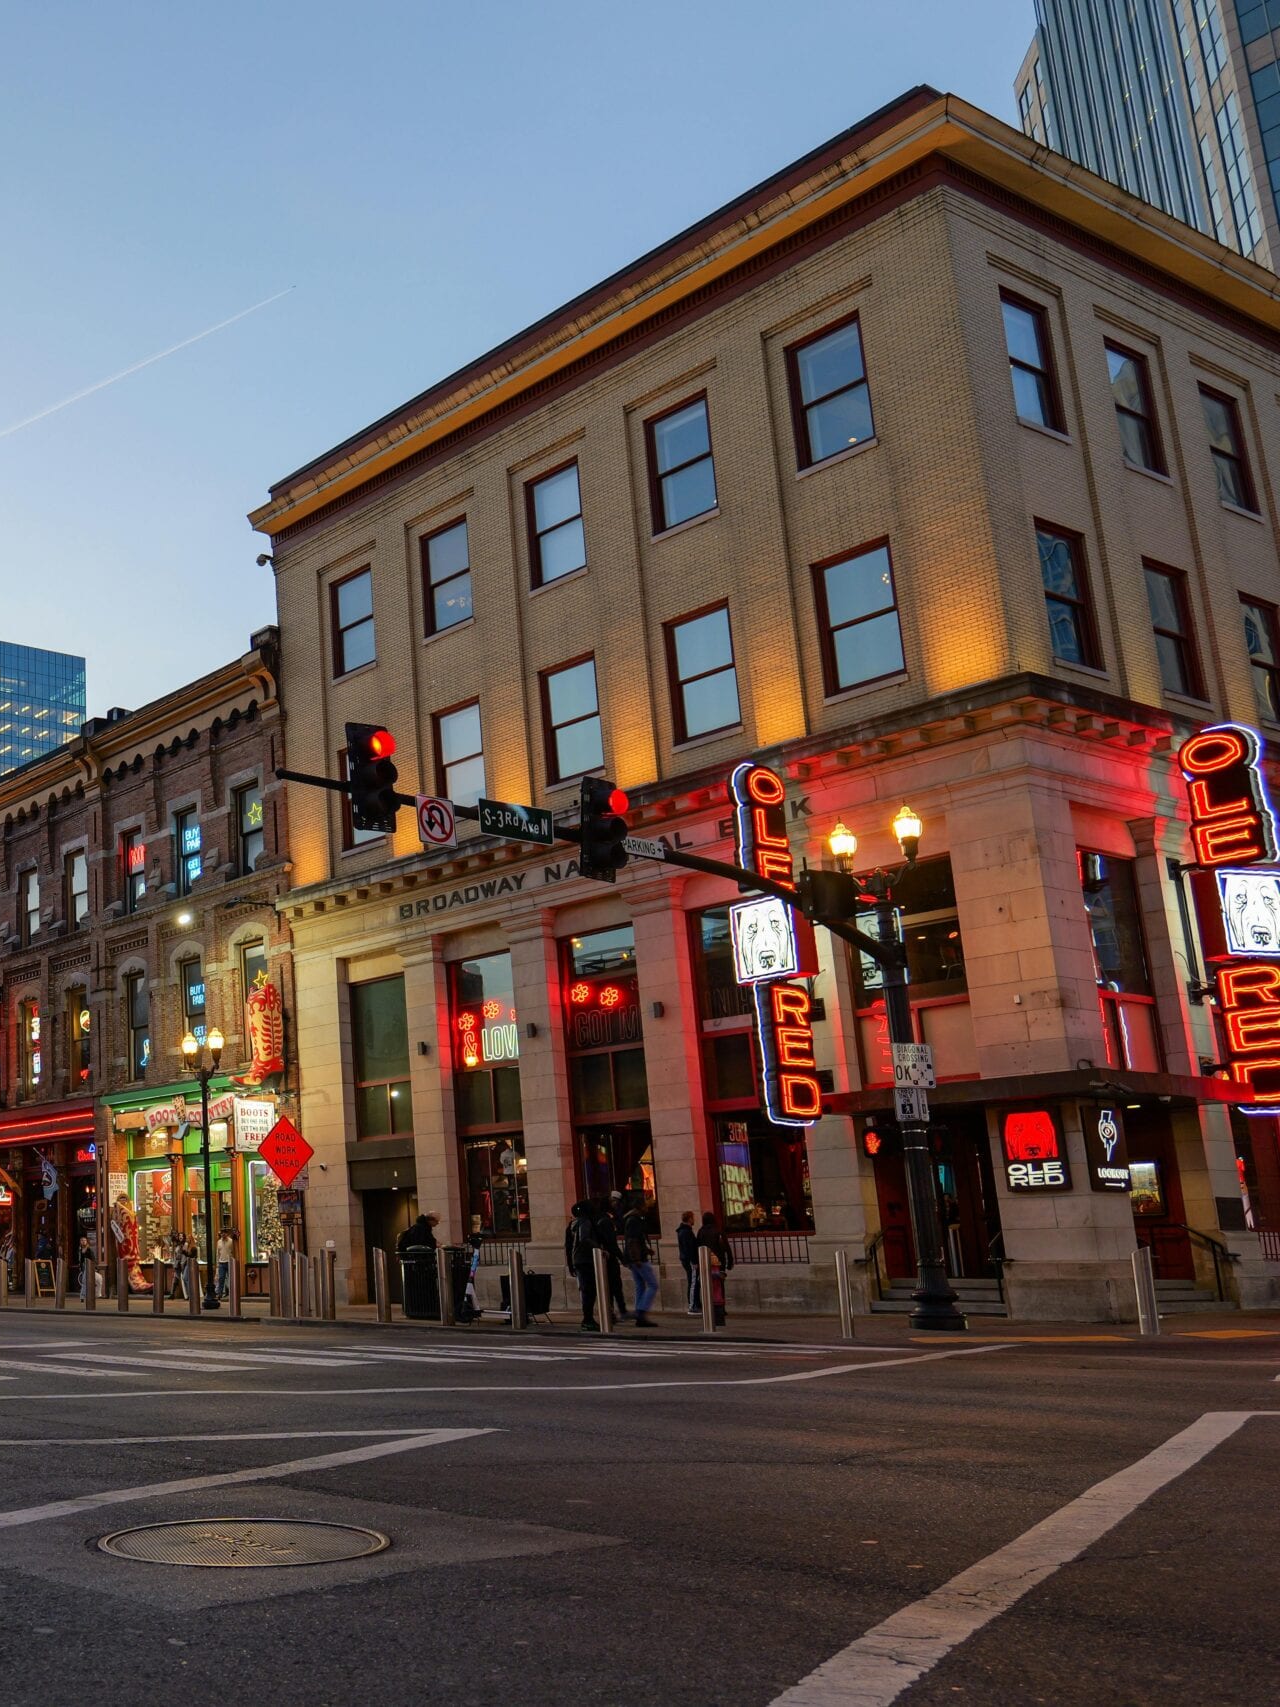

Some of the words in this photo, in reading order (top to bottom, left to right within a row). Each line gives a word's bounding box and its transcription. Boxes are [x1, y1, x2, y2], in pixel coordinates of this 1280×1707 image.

[1181, 732, 1260, 865] OLE
[540, 821, 549, 836] N
[747, 768, 795, 891] OLE
[621, 838, 656, 856] PARKING
[399, 872, 527, 921] BROADWAY
[481, 1023, 519, 1062] LOV
[896, 1045, 929, 1054] DIAGONAL
[773, 986, 820, 1116] RED
[898, 1053, 929, 1063] CROSSING
[895, 1065, 912, 1081] OK
[149, 1109, 177, 1128] BOOT
[187, 1095, 235, 1121] CONTRY
[240, 1108, 269, 1117] BOOTS
[245, 1132, 266, 1141] FREE
[275, 1133, 296, 1142] ROAD
[275, 1145, 297, 1154] WORK
[274, 1158, 300, 1168] AHEAD
[1007, 1161, 1063, 1175] OLE
[1009, 1173, 1065, 1187] RED
[1098, 1167, 1129, 1180] LOOKOUT
